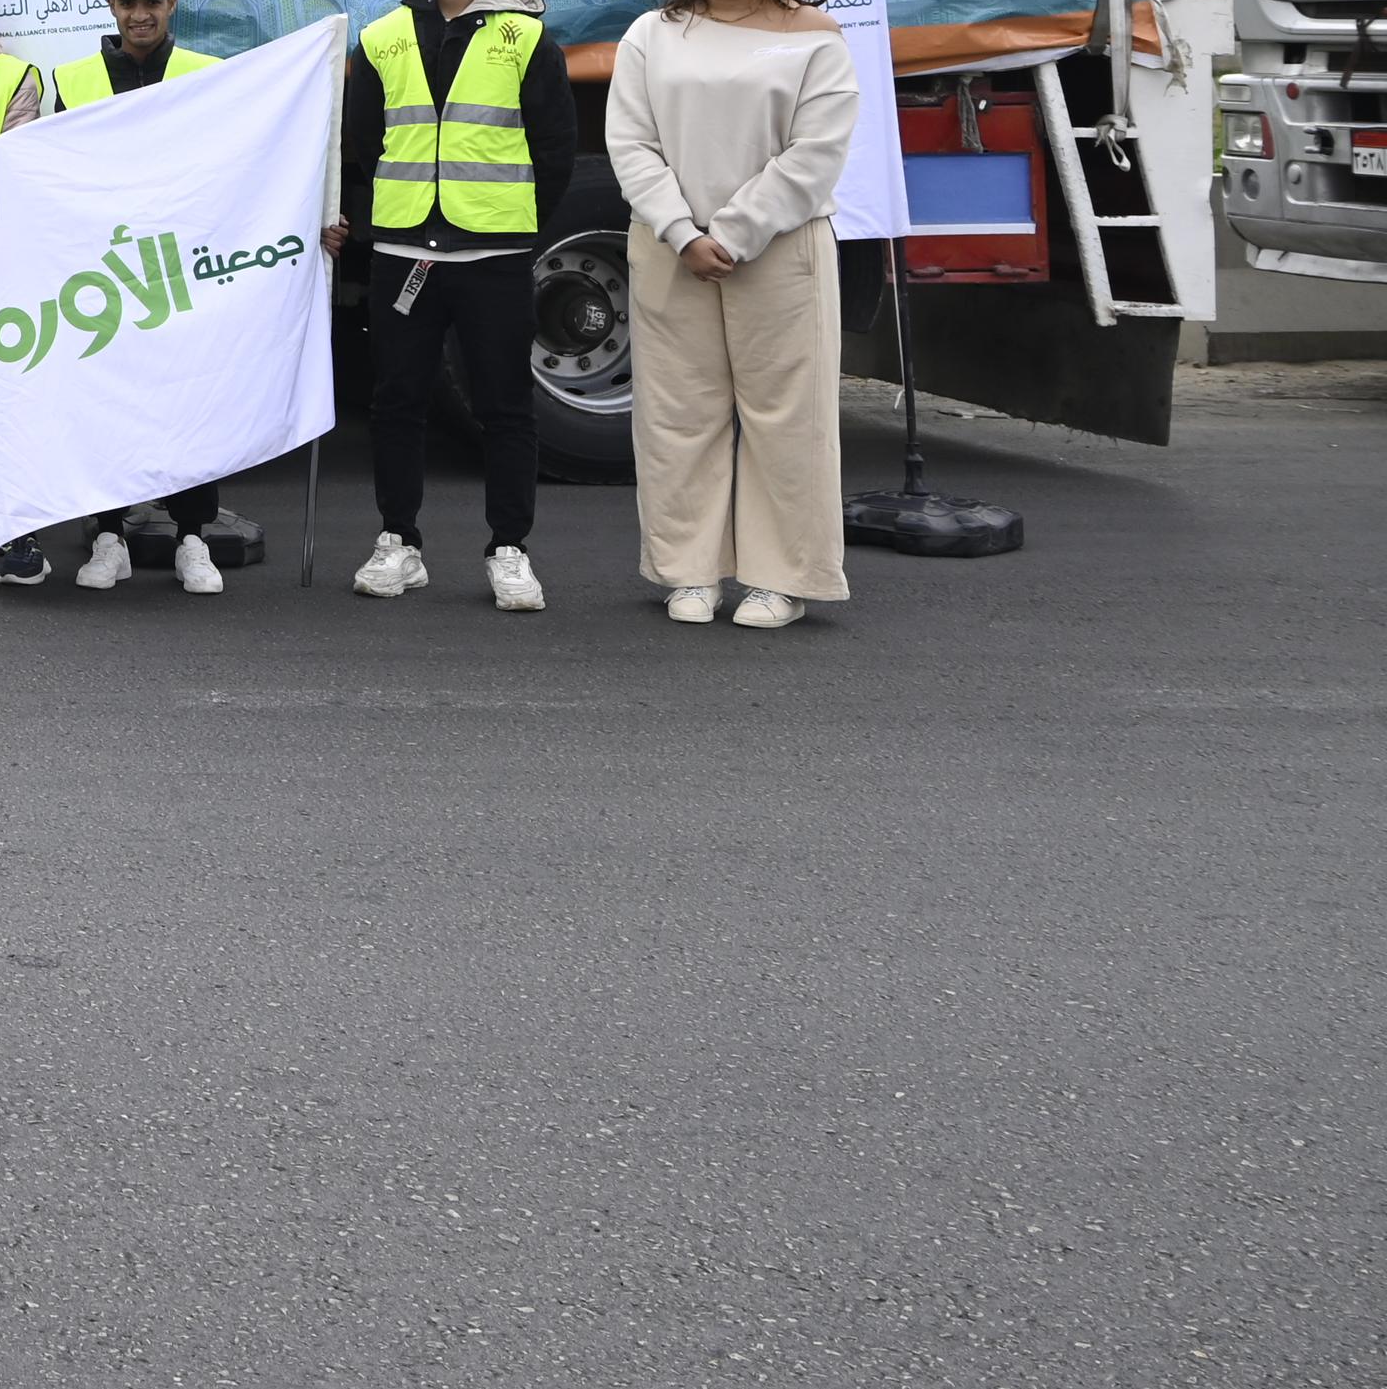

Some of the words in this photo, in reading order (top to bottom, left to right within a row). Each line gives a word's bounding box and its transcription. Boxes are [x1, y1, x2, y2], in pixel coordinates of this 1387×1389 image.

[15, 29, 46, 37] ALLIANCE
[72, 22, 116, 32] DEVELOPMENT
[374, 37, 408, 60] الأورما
[192, 235, 305, 286] جمعية
[405, 268, 426, 296] DIESEL
